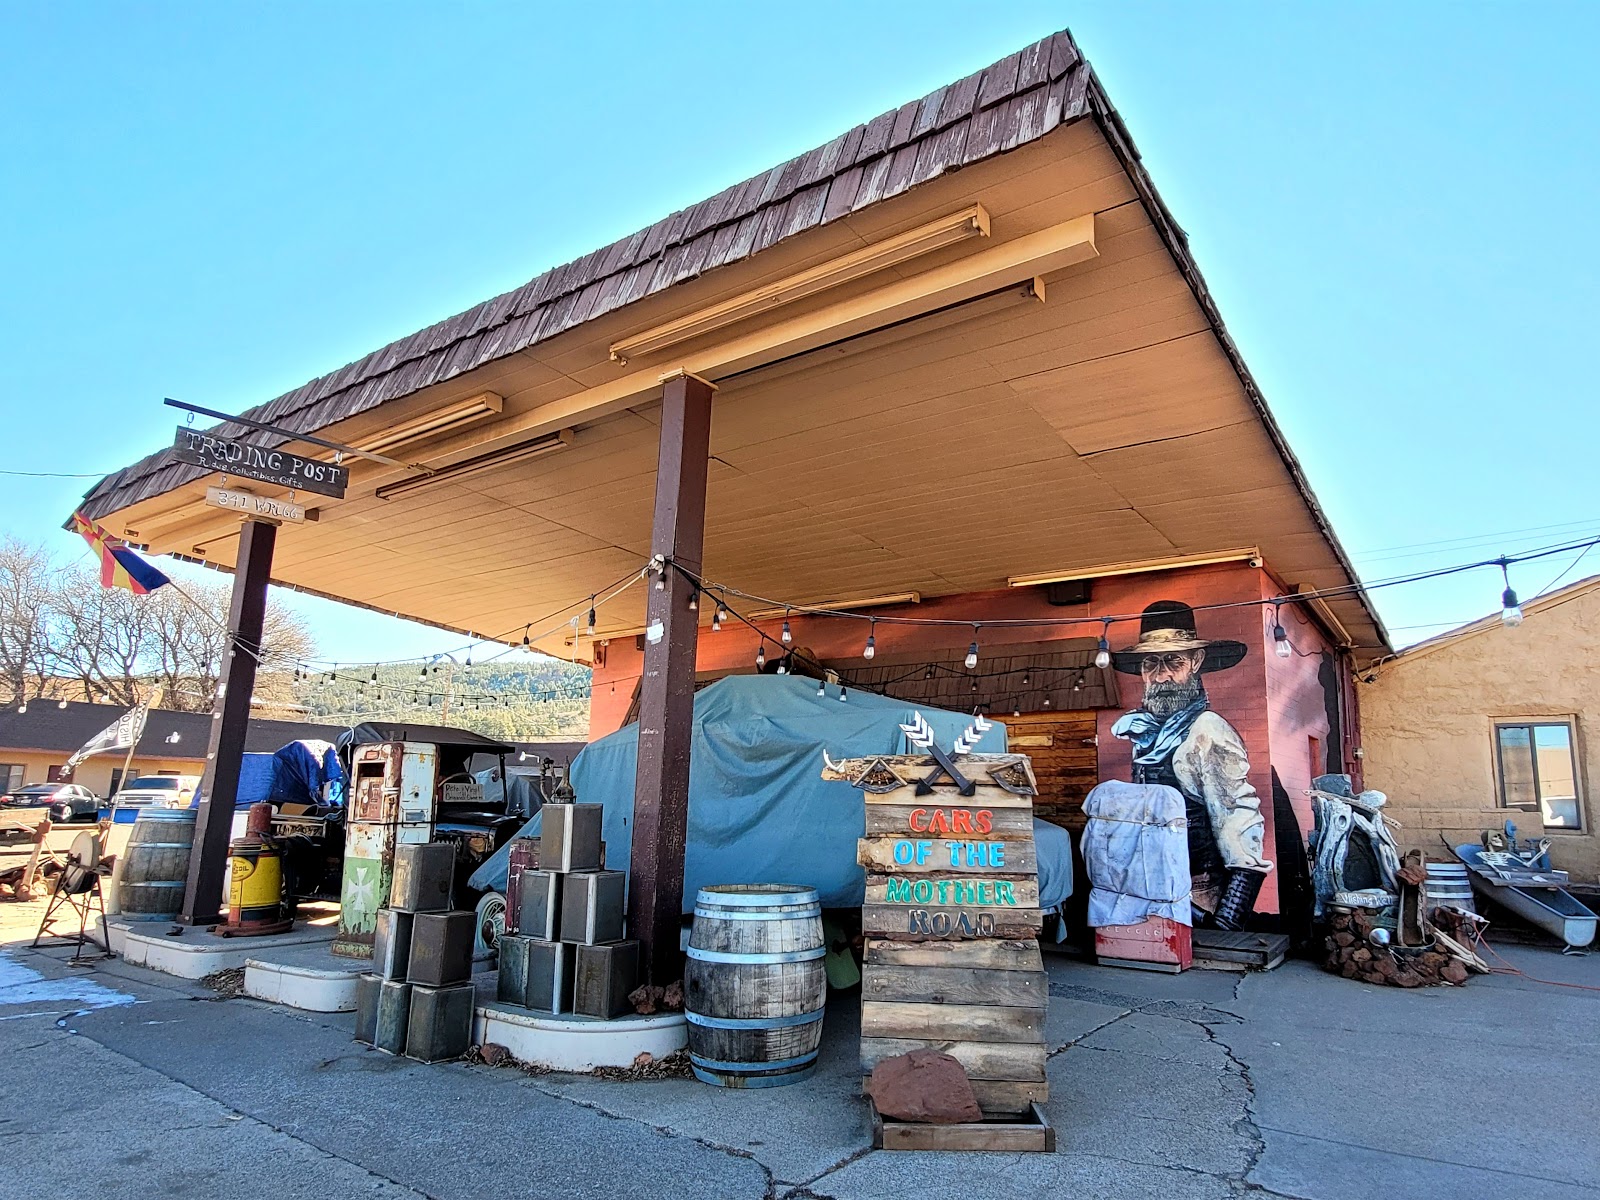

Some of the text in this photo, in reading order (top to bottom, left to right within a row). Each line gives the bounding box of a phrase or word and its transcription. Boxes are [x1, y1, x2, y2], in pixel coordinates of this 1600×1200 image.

[186, 431, 341, 484] TRADING POST
[218, 491, 249, 509] 341
[908, 808, 994, 834] CARS
[893, 840, 1006, 868] OF THE
[885, 877, 1018, 906] MOTHER
[1340, 893, 1373, 907] Wishing
[908, 909, 996, 938] ROAD
